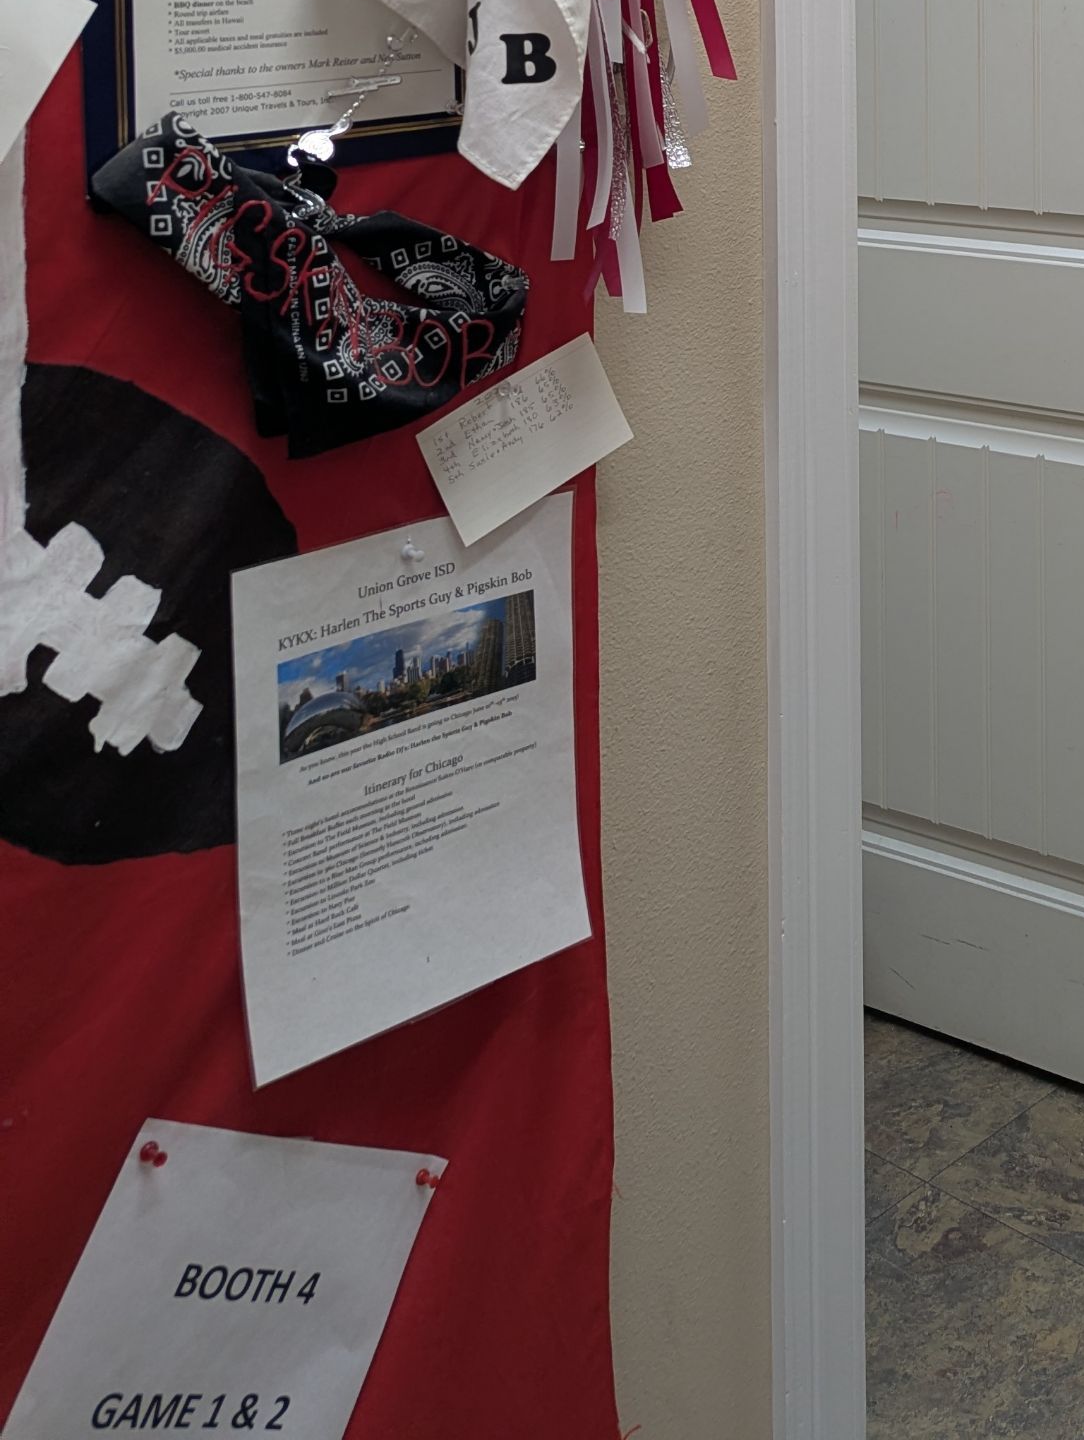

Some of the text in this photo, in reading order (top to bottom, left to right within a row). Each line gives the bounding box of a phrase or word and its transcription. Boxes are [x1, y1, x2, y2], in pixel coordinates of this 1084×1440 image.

[215, 65, 246, 77] thanks
[247, 64, 257, 74] to
[259, 62, 274, 73] the
[275, 61, 306, 71] owners
[308, 57, 331, 69] Mark
[331, 55, 358, 68] Reiter
[359, 53, 376, 64] and
[499, 32, 557, 85] B
[169, 98, 185, 108] Call
[187, 98, 197, 107] us
[198, 96, 210, 106] toll
[211, 95, 228, 105] free
[176, 106, 208, 120] opyright
[209, 104, 229, 114] 2007
[231, 101, 258, 114] Unique
[260, 100, 287, 111] Travels
[356, 561, 456, 599] Union Grove ISD
[278, 569, 534, 651] KYKX: Harlen The Sports Guy & Pigskin Bob
[364, 752, 465, 797] Itinerary for Chicago
[174, 1263, 322, 1305] BOOTH 4
[92, 1393, 291, 1431] GAME 1 & 2
